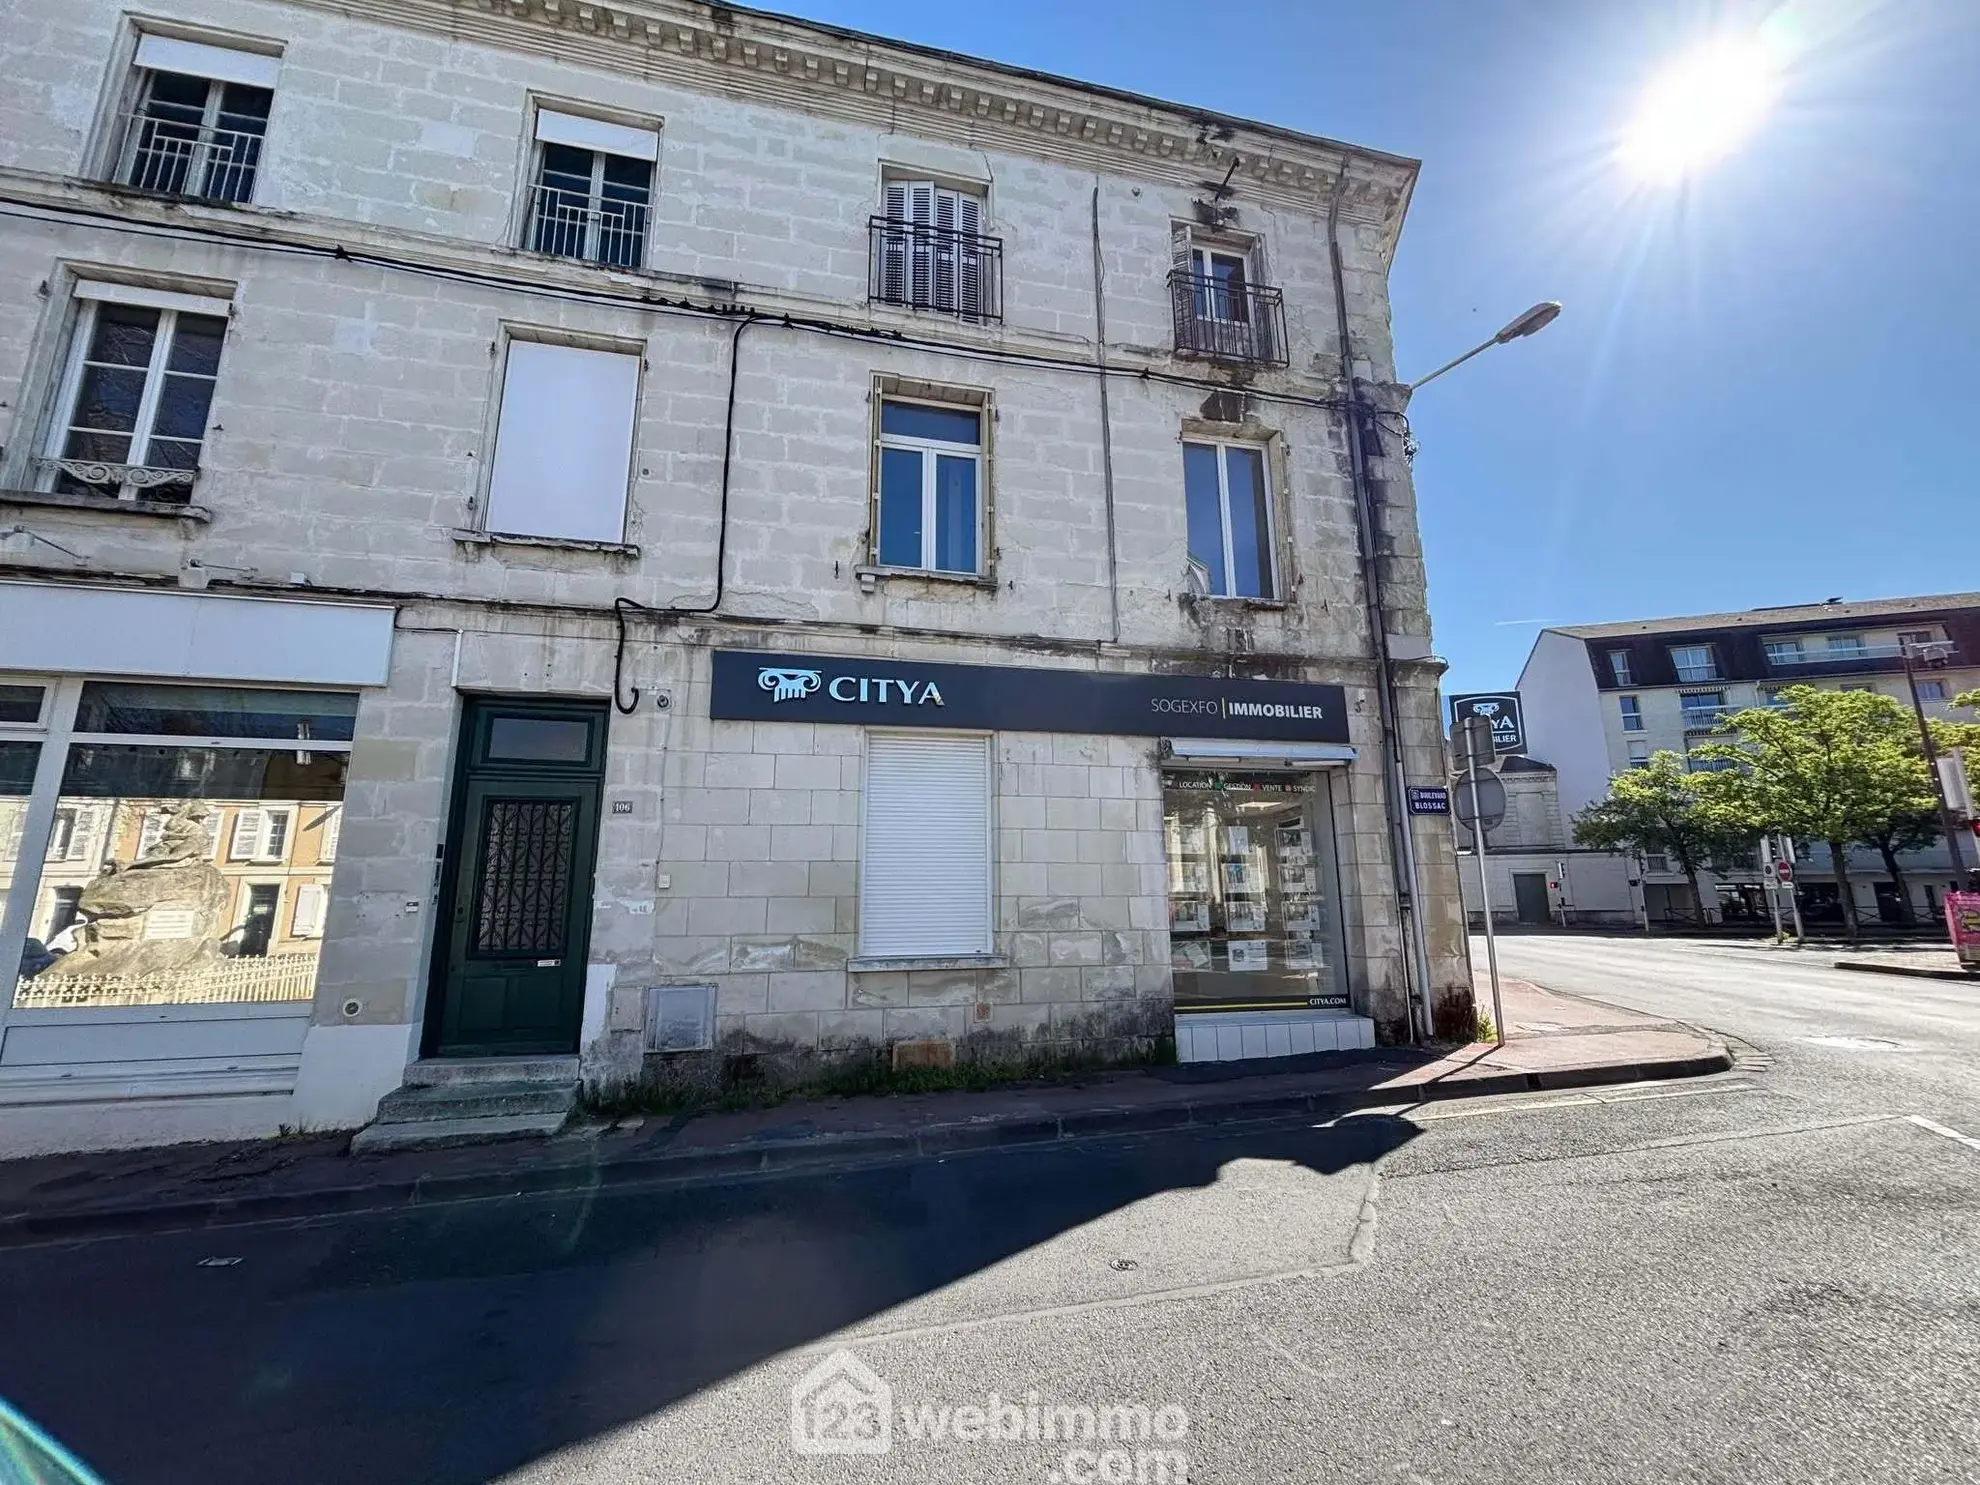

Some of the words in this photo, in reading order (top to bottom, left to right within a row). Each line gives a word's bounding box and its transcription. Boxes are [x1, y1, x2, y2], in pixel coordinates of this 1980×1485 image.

[828, 676, 945, 706] CITYA
[1151, 698, 1218, 715] SOGEXFO
[1228, 702, 1323, 719] IMMOBILIER
[1179, 781, 1212, 789] LOCATION
[615, 802, 630, 812] 106
[1414, 801, 1446, 810] BLOSSAC
[1309, 997, 1347, 1006] CITYA.COM
